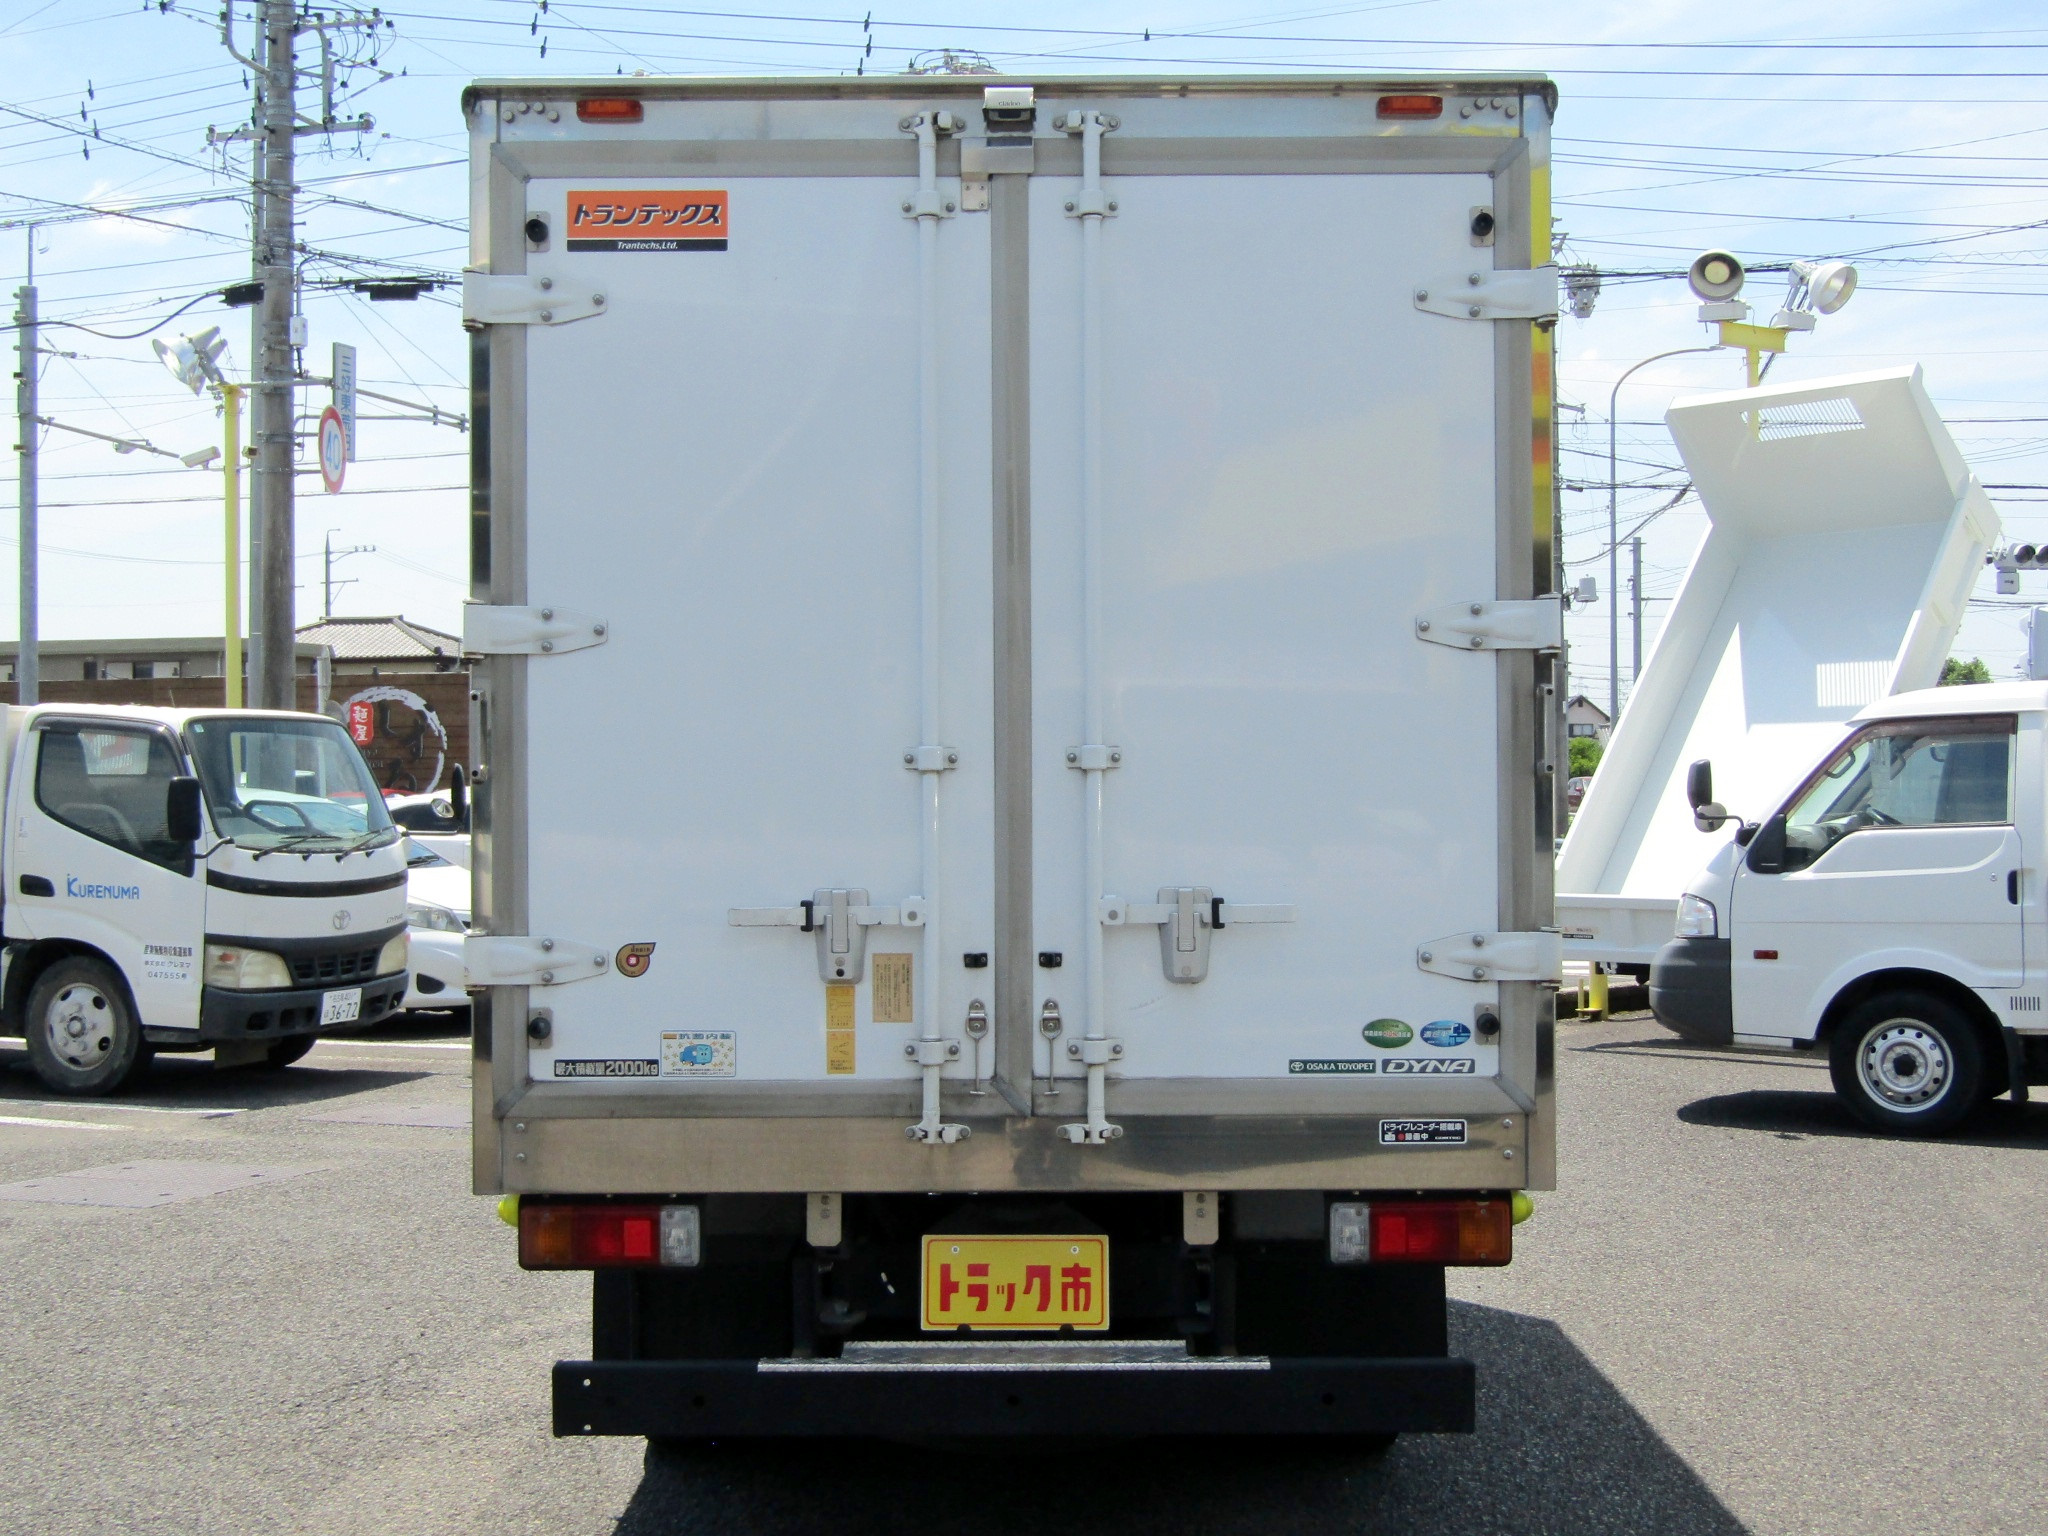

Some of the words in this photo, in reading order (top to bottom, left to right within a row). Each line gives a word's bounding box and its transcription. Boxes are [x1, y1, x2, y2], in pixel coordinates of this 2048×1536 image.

[573, 203, 723, 227] トランテックス
[617, 241, 679, 250] Trantechs,Ltd.
[325, 430, 340, 471] 40
[329, 1001, 358, 1021] 36-72
[555, 1060, 659, 1076] 最大積載量2000kg
[1306, 1062, 1336, 1071] OSAKA
[1337, 1062, 1375, 1071] TOYOPET
[1385, 1059, 1473, 1073] DYNA
[1384, 1122, 1463, 1131] ドライブレコーダー搭載車
[939, 1262, 1092, 1312] トラック市
